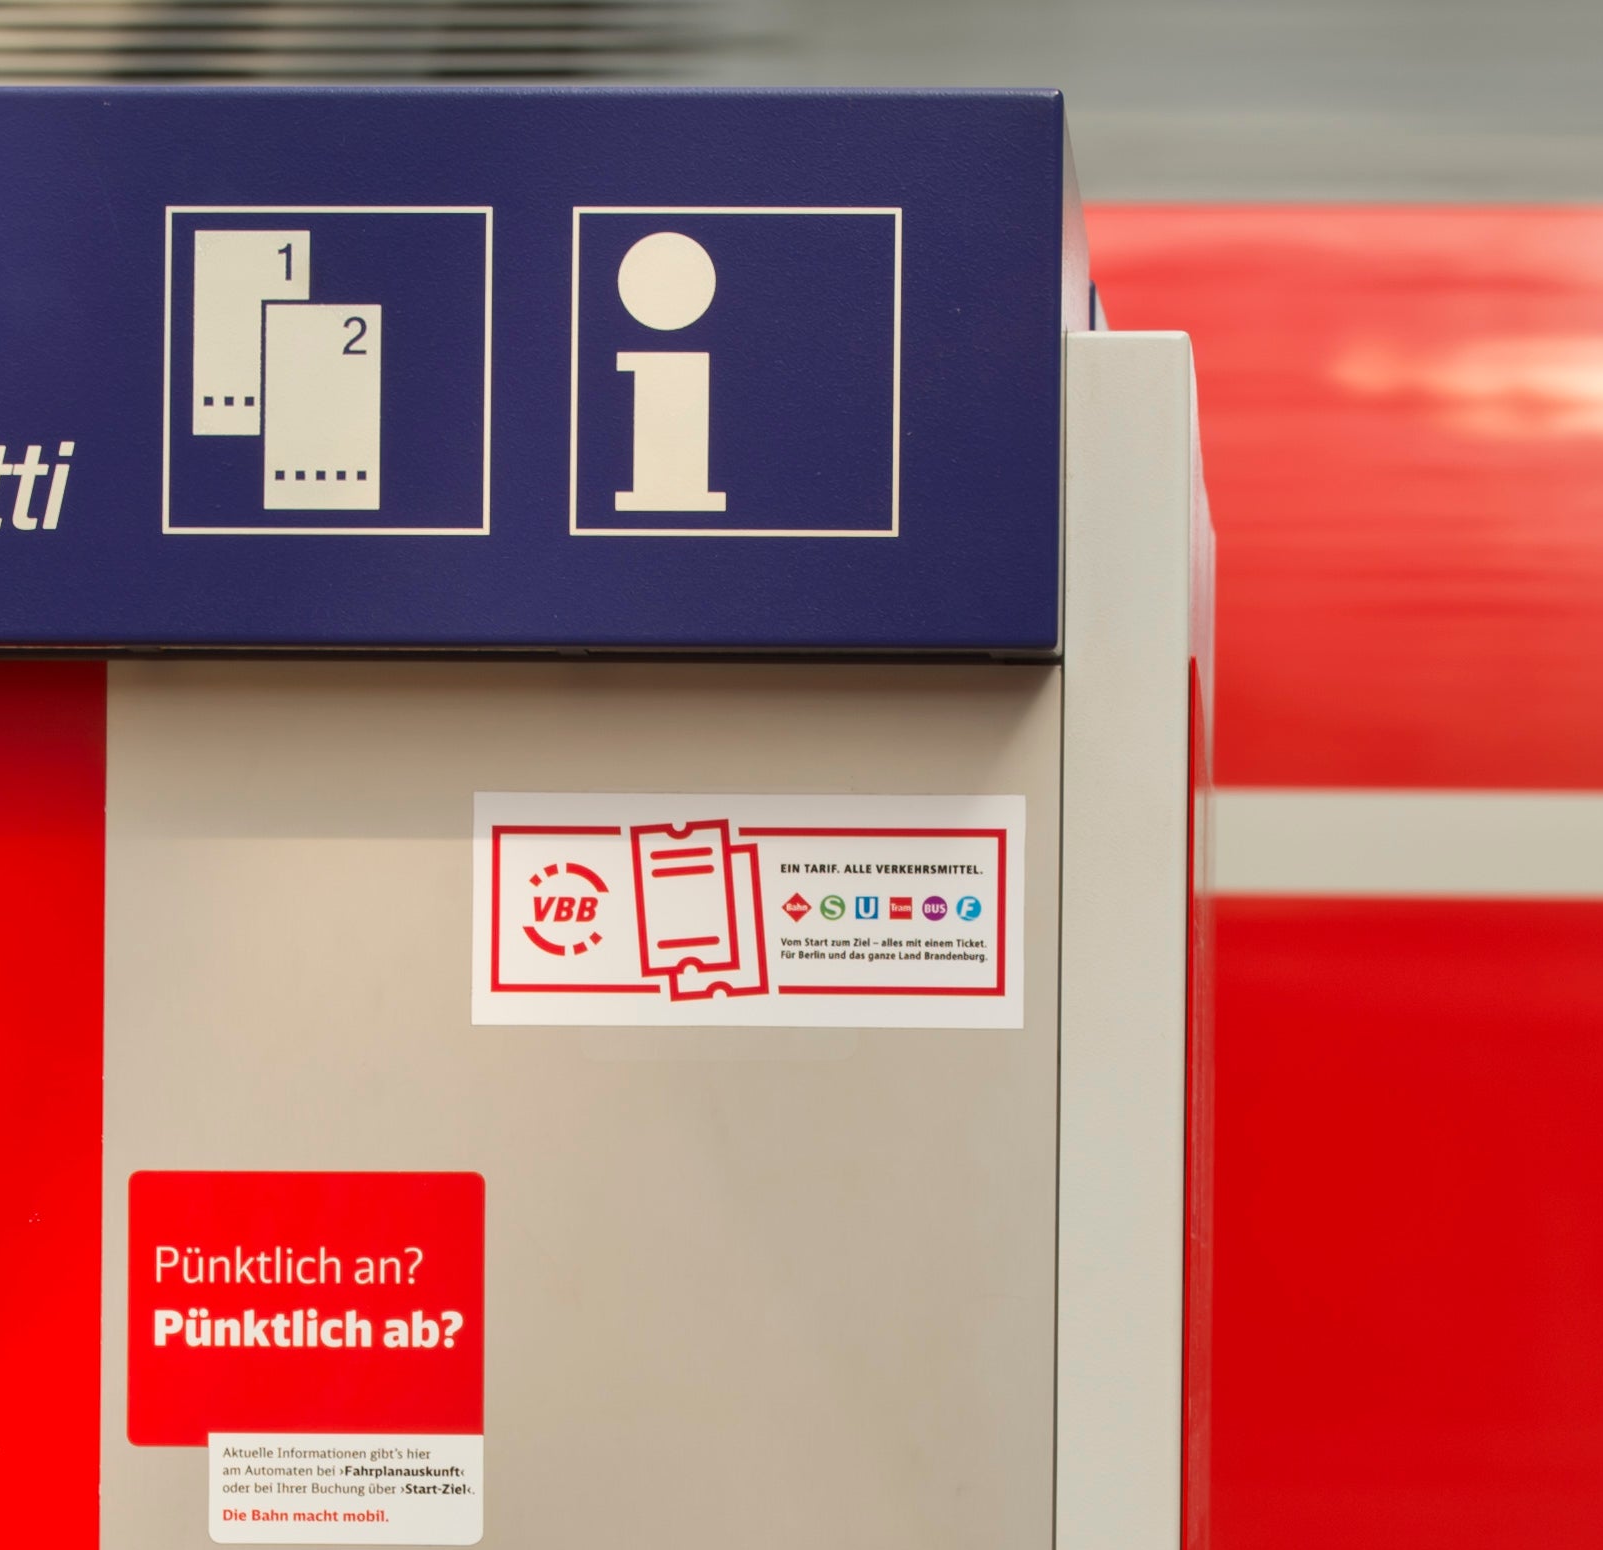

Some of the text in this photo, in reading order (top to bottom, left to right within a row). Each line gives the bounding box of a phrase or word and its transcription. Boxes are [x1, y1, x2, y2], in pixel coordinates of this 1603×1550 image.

[276, 243, 293, 282] 1
[342, 317, 368, 356] 2
[781, 864, 984, 875] EIN TARIF. ALLE VERKEHRSMITTEL.
[532, 896, 599, 922] VBB
[786, 903, 808, 912] Bahn
[823, 896, 843, 919] S
[858, 898, 876, 918] U
[890, 904, 912, 912] Tram
[924, 903, 946, 914] BUS
[959, 899, 976, 917] F
[781, 938, 799, 947] Vom
[805, 938, 828, 947] Start
[831, 940, 850, 948] zum
[853, 938, 871, 947] Ziel
[881, 938, 903, 948] alles
[906, 939, 922, 948] mit
[925, 939, 953, 949] einem
[956, 939, 987, 949] Ticket.
[781, 950, 988, 963] Für Berlin und das ganze Land Brandenburg.
[155, 1245, 424, 1285] Pünktlich an?
[153, 1308, 464, 1349] Pünktlich ab?
[223, 1447, 431, 1462] Aktuelle Informationen gibt's hier
[222, 1467, 241, 1477] am
[245, 1465, 313, 1477] Automaten
[317, 1465, 335, 1477] bei
[222, 1483, 249, 1494] oder
[254, 1483, 273, 1494] bei
[277, 1483, 307, 1495] Ihrer
[312, 1483, 365, 1497] Buchung
[368, 1483, 396, 1495] über
[222, 1509, 389, 1523] Die Bahn macht mobil.
